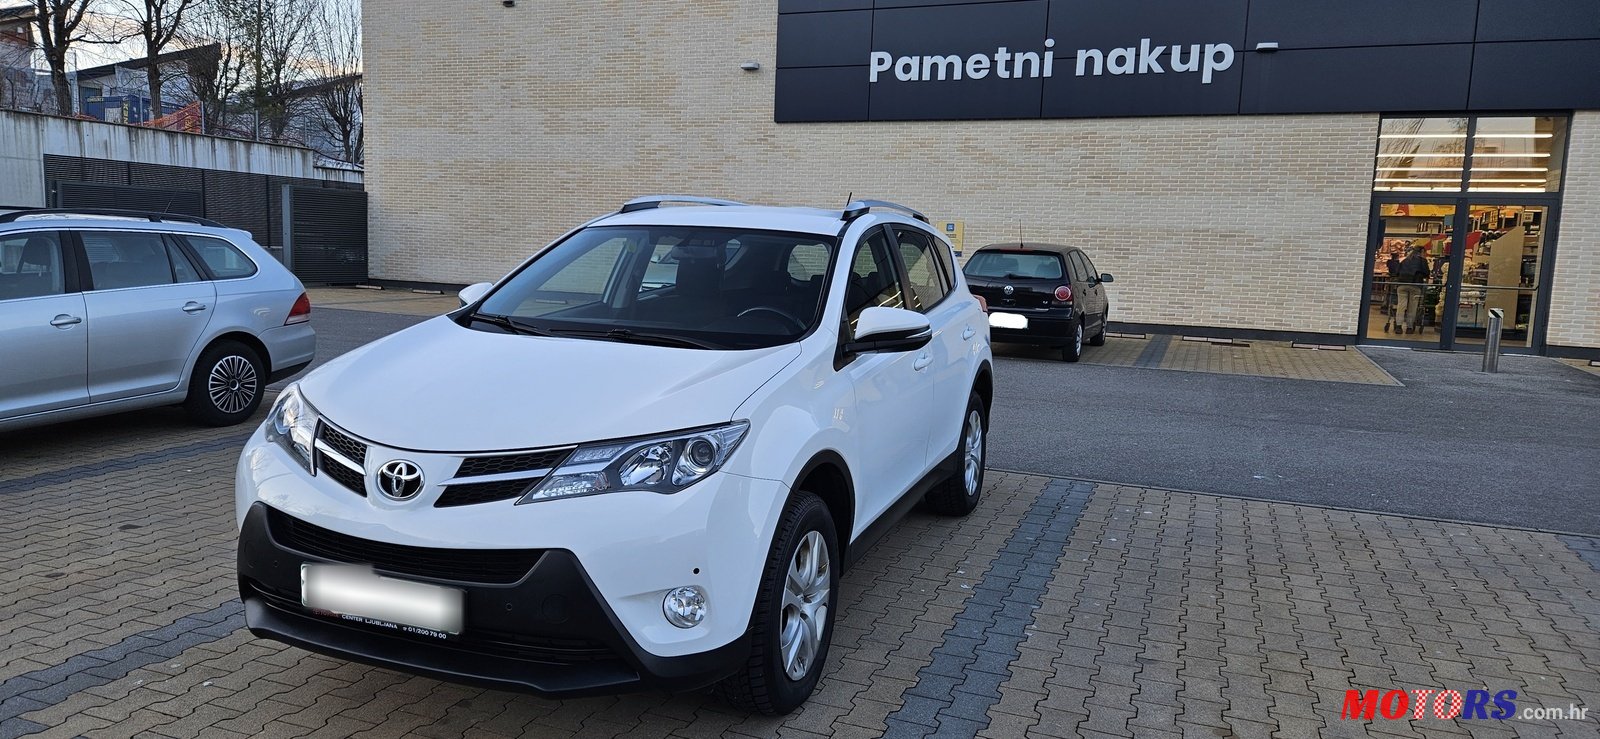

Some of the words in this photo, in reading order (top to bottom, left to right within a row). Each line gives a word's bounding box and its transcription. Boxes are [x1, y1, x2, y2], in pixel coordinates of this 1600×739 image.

[869, 38, 1055, 83] Pametni
[1075, 38, 1235, 84] nakup
[341, 614, 363, 623] CENTER
[365, 618, 398, 630] LJUBLJANA
[438, 632, 447, 640] 00
